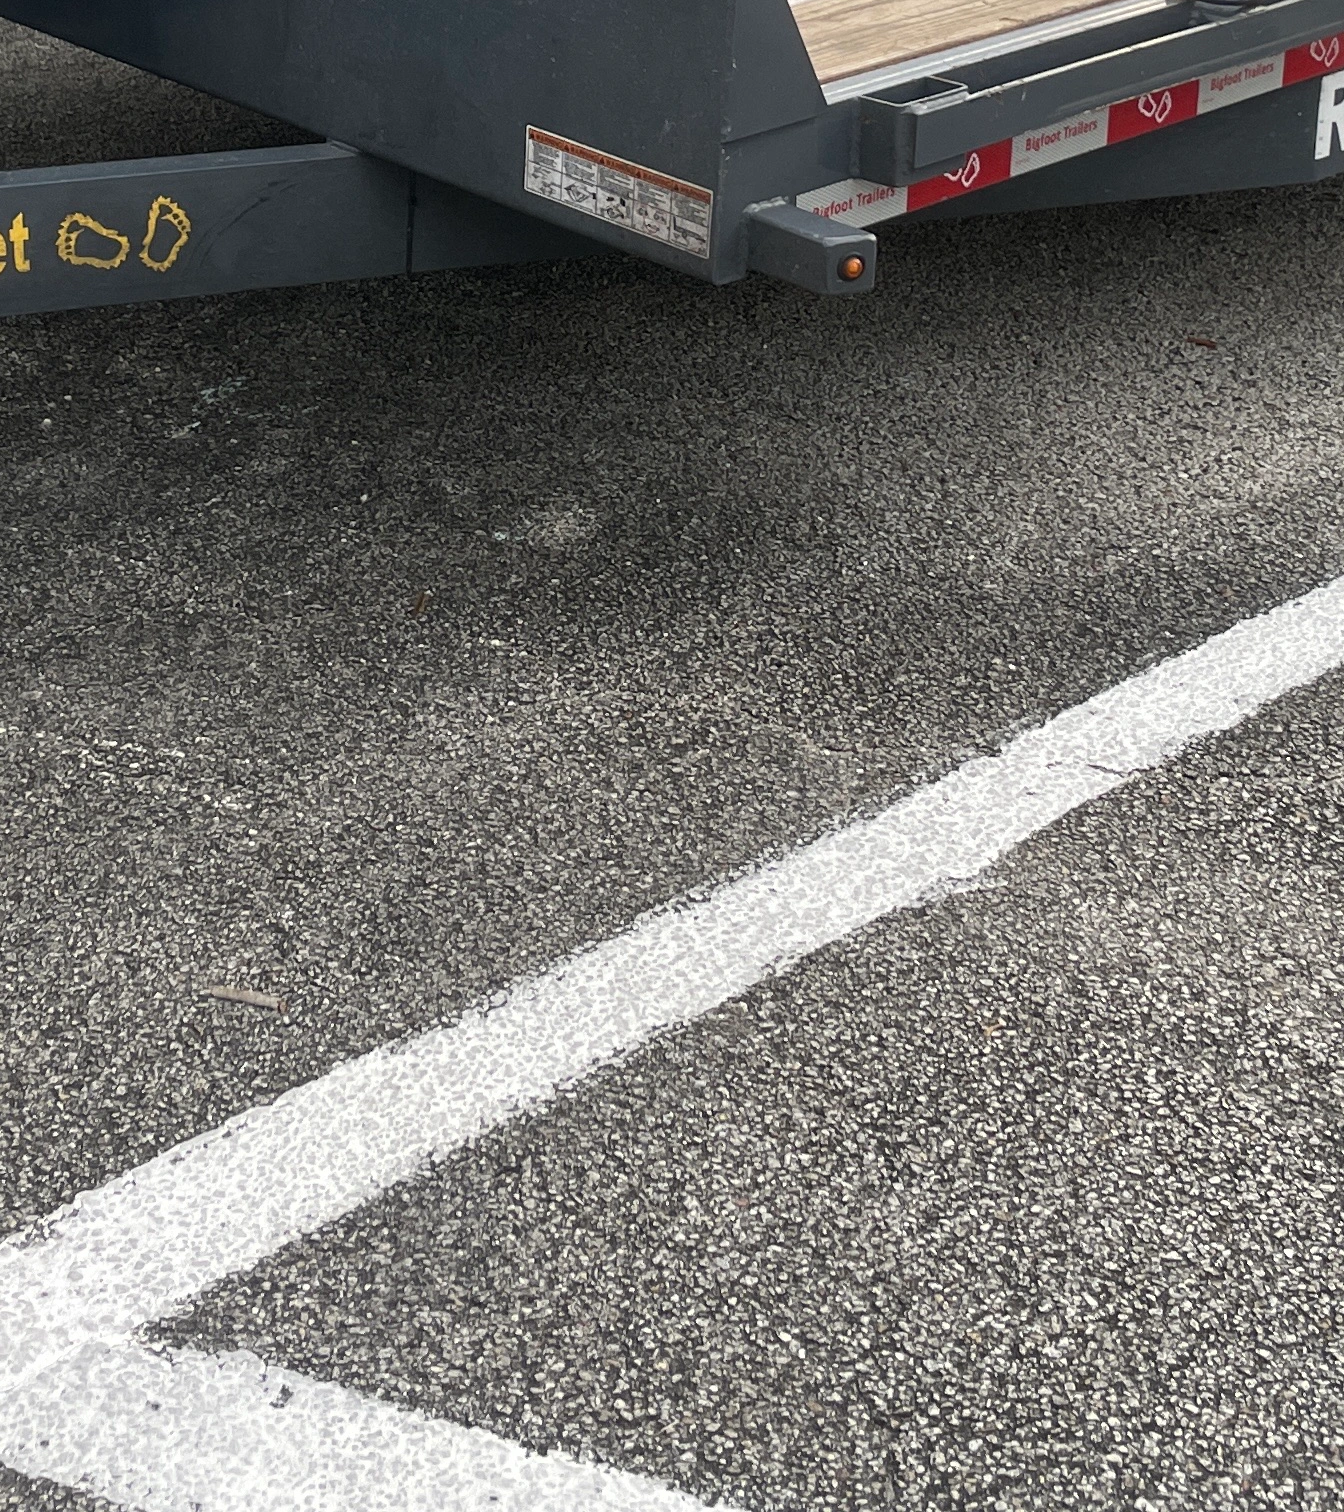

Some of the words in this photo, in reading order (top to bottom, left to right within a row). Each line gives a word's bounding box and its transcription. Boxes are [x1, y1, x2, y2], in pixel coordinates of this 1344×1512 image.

[1210, 71, 1243, 92] Bigfoot
[1244, 62, 1275, 81] Trailers
[1025, 129, 1062, 152] Bigfoot
[1063, 119, 1098, 140] Trailers
[856, 186, 896, 207] Trailers
